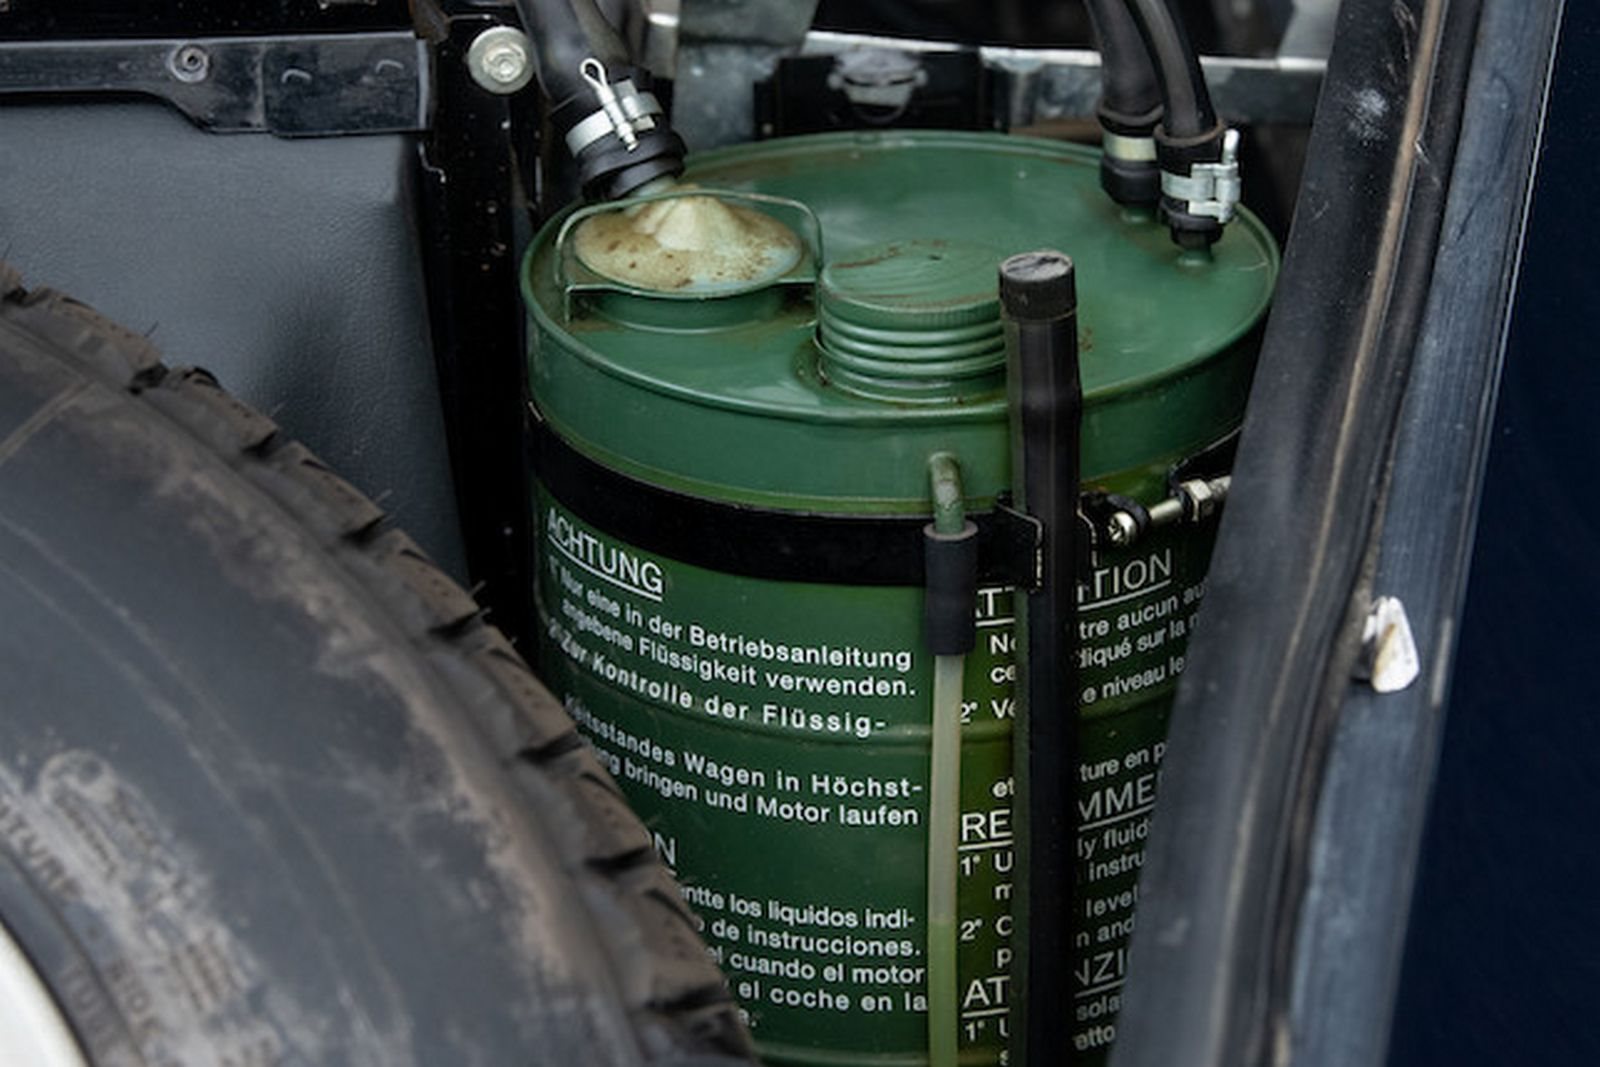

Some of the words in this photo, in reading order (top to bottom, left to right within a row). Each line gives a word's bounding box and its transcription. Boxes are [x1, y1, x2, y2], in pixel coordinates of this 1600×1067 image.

[548, 508, 662, 595] ACHTUNG
[587, 589, 620, 617] eine
[625, 602, 642, 628] in
[648, 615, 683, 640] der
[689, 625, 912, 672] Betriebsanleitung
[1117, 595, 1178, 631] aucun
[638, 636, 757, 686] Flüssigkeit
[765, 670, 916, 697] verwenden.
[1101, 664, 1166, 699] niveau
[592, 652, 693, 709] Kontrolle
[704, 694, 749, 721] der
[762, 704, 887, 738] Flüssig-
[683, 750, 766, 787] Wagen
[776, 769, 800, 792] in
[811, 774, 923, 798] Höchst-
[1124, 748, 1150, 769] en
[624, 757, 698, 801] bringen
[705, 789, 748, 813] und
[756, 795, 830, 824] Motor
[838, 803, 920, 826] laufen
[730, 893, 763, 918] los
[768, 899, 858, 928] liquidos
[864, 908, 915, 929] indi-
[711, 918, 740, 942] de
[747, 923, 922, 957] instrucciones.
[730, 952, 816, 981] cuando
[823, 962, 844, 983] el
[851, 964, 925, 985] motor
[738, 980, 760, 1000] el
[769, 988, 850, 1012] coche
[860, 991, 894, 1011] en
[904, 990, 928, 1012] la
